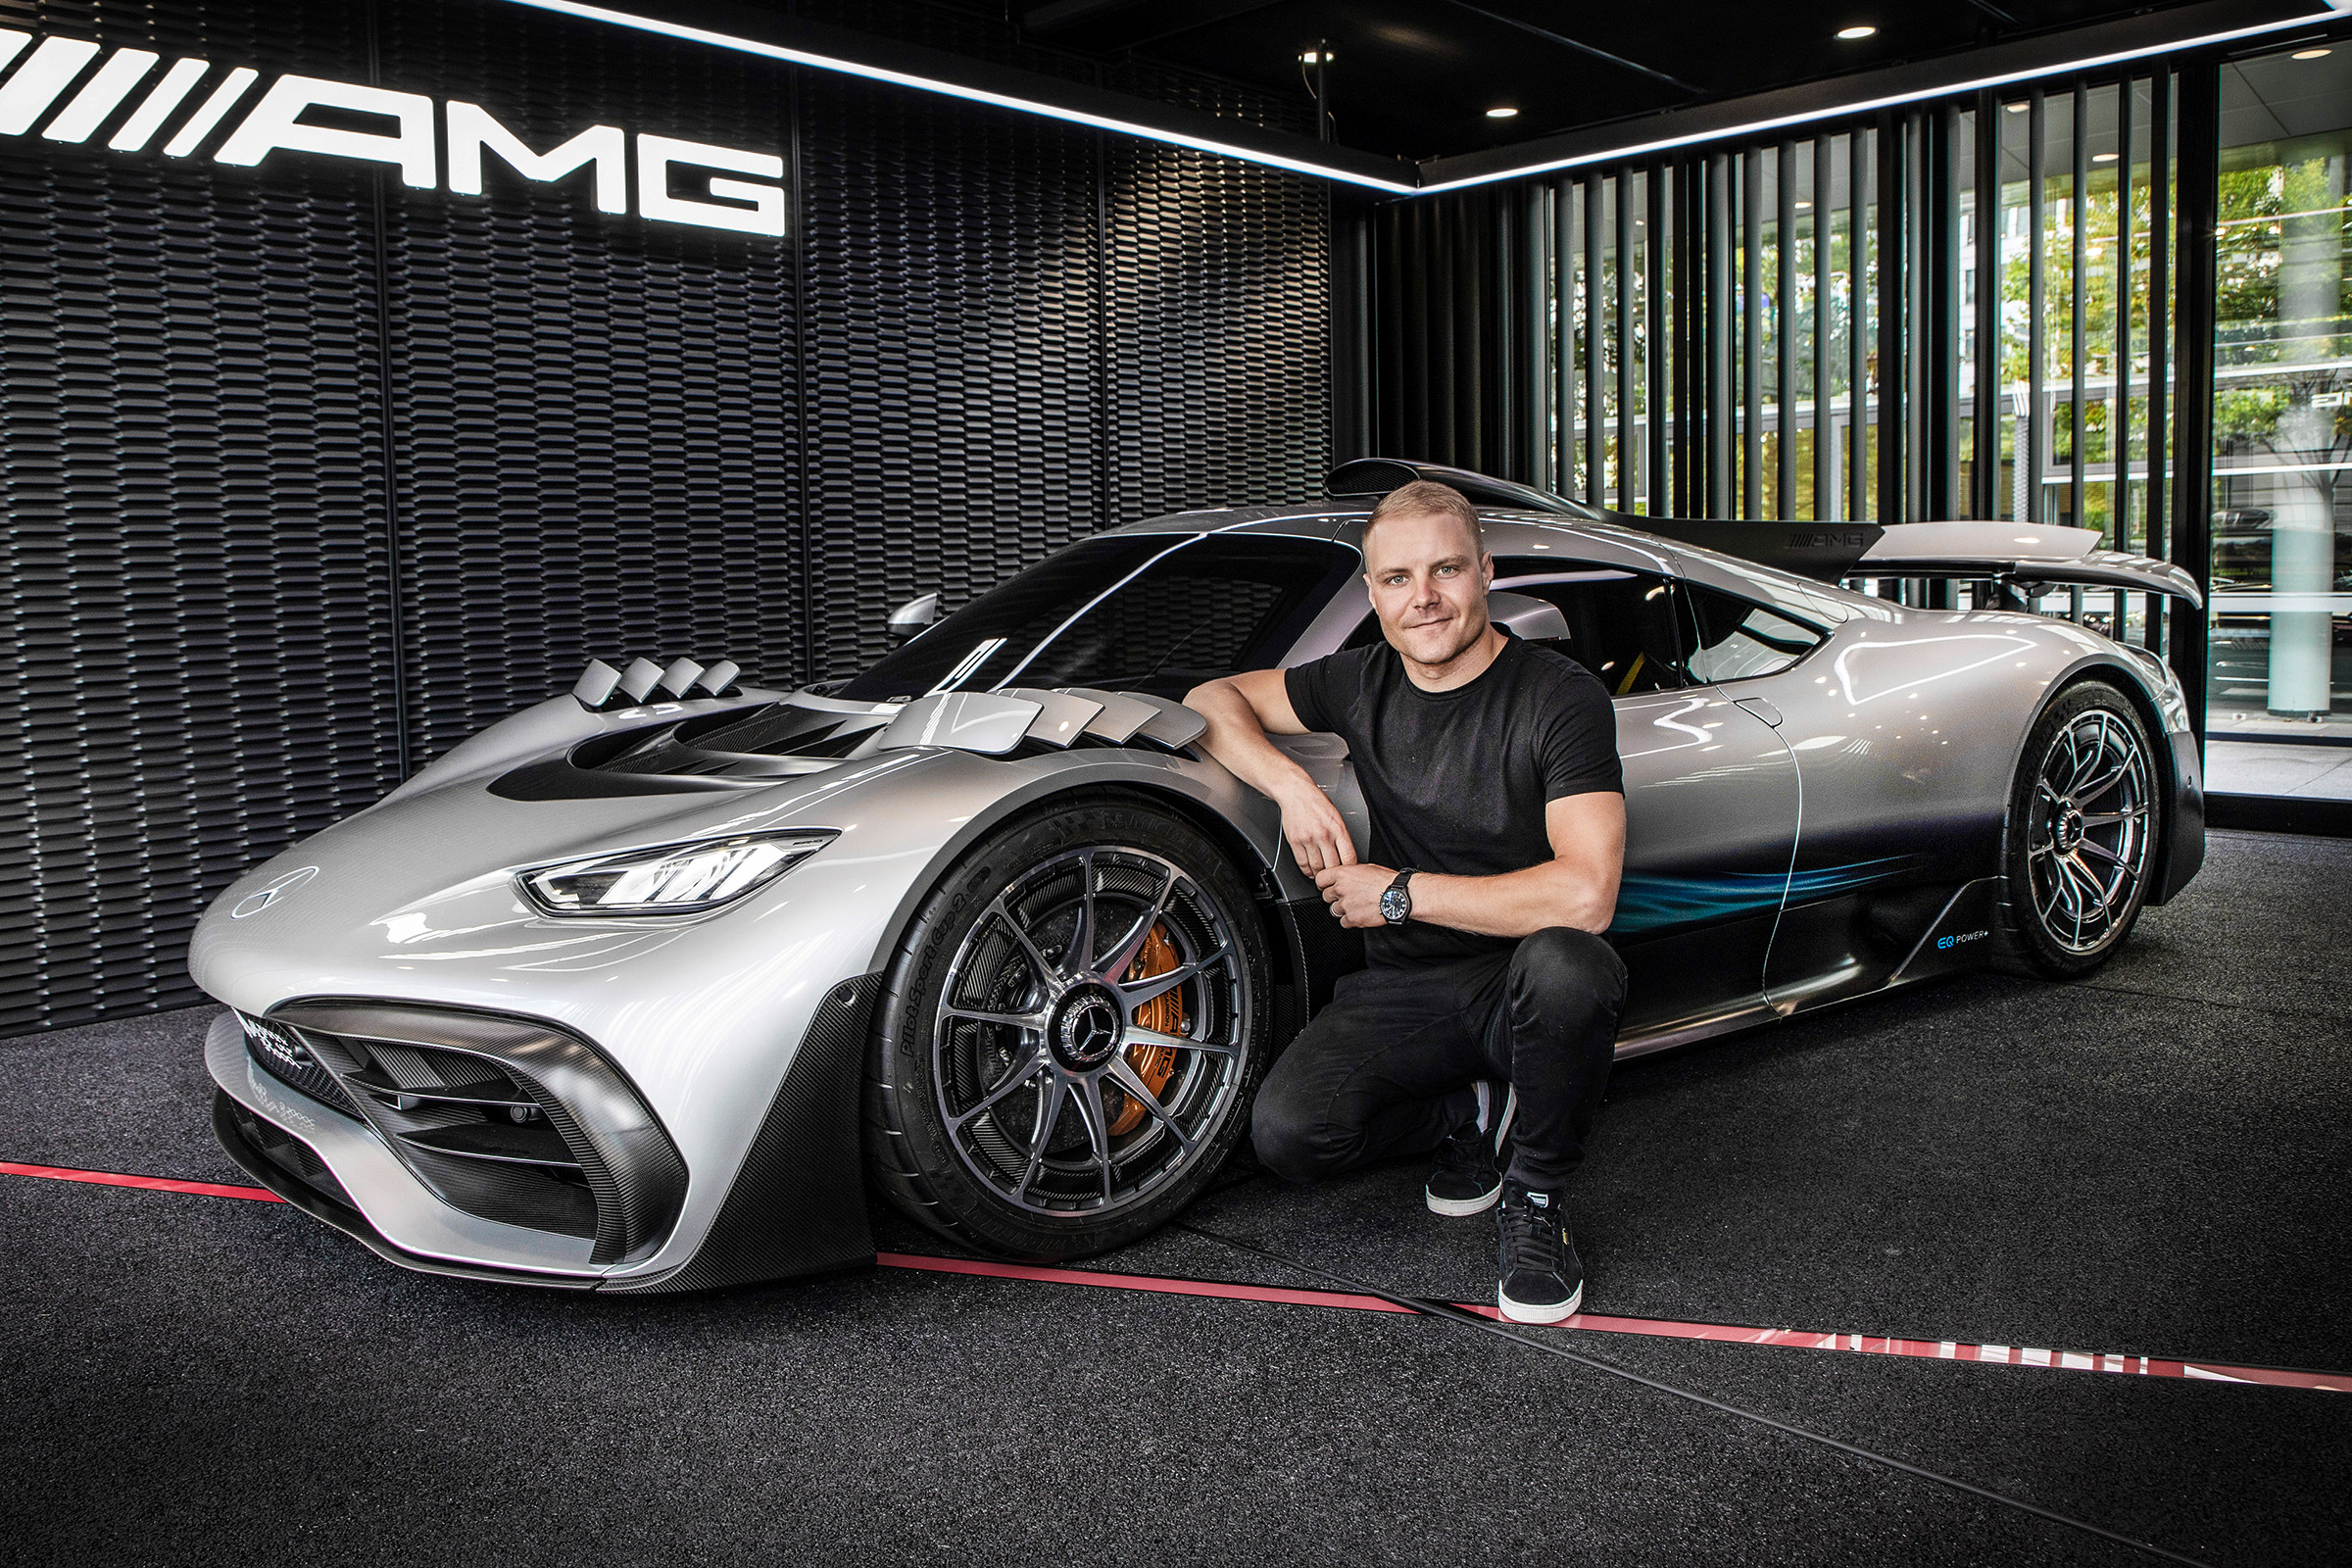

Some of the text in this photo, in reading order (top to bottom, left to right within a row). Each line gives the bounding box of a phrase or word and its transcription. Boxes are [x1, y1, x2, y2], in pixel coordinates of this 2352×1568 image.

[214, 74, 785, 237] AMG
[1811, 533, 1863, 548] AMG
[907, 944, 938, 1005] Sport
[930, 912, 957, 947] Cup
[952, 892, 967, 913] 2
[1937, 936, 1954, 949] EQ
